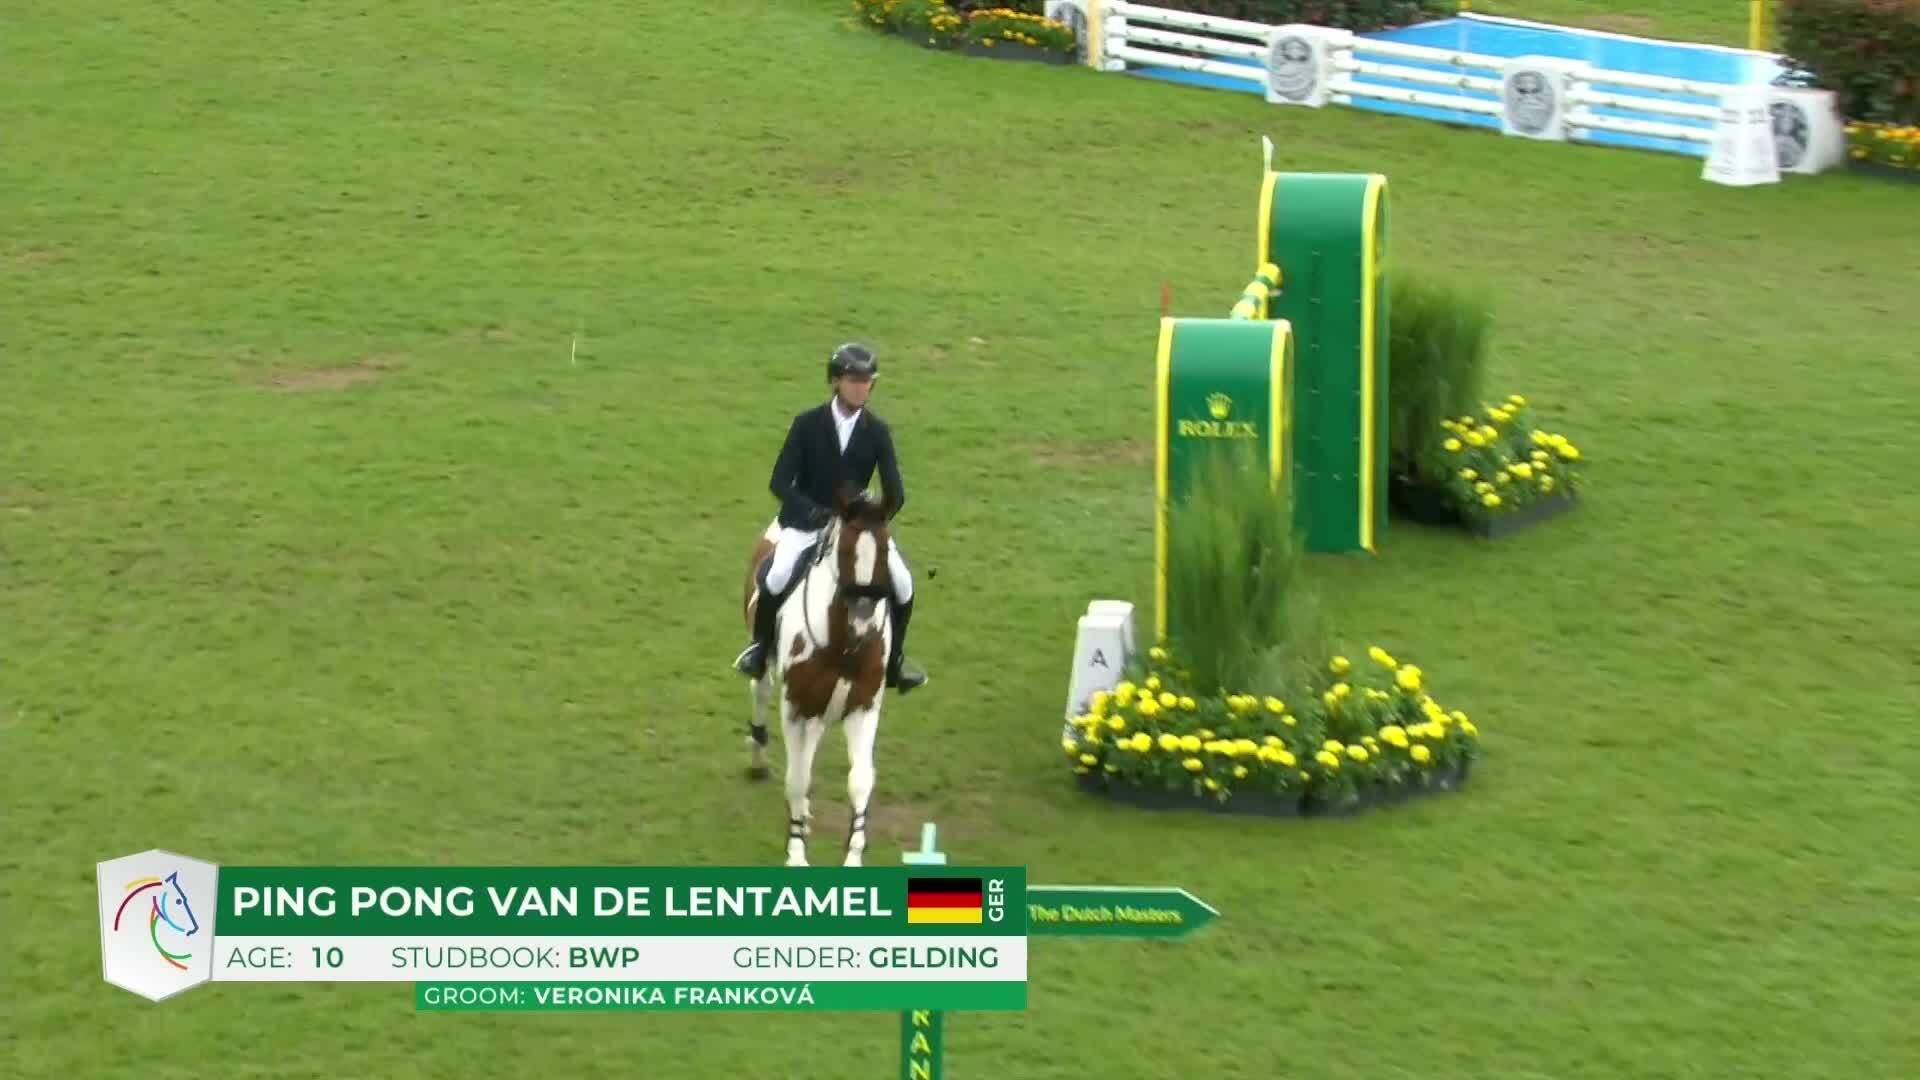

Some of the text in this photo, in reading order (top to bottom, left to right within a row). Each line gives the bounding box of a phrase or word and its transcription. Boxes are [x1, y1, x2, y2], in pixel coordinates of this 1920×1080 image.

[1178, 419, 1258, 438] ROLEX
[1090, 648, 1110, 669] A
[1030, 904, 1060, 921] The
[1061, 904, 1113, 921] Dutch
